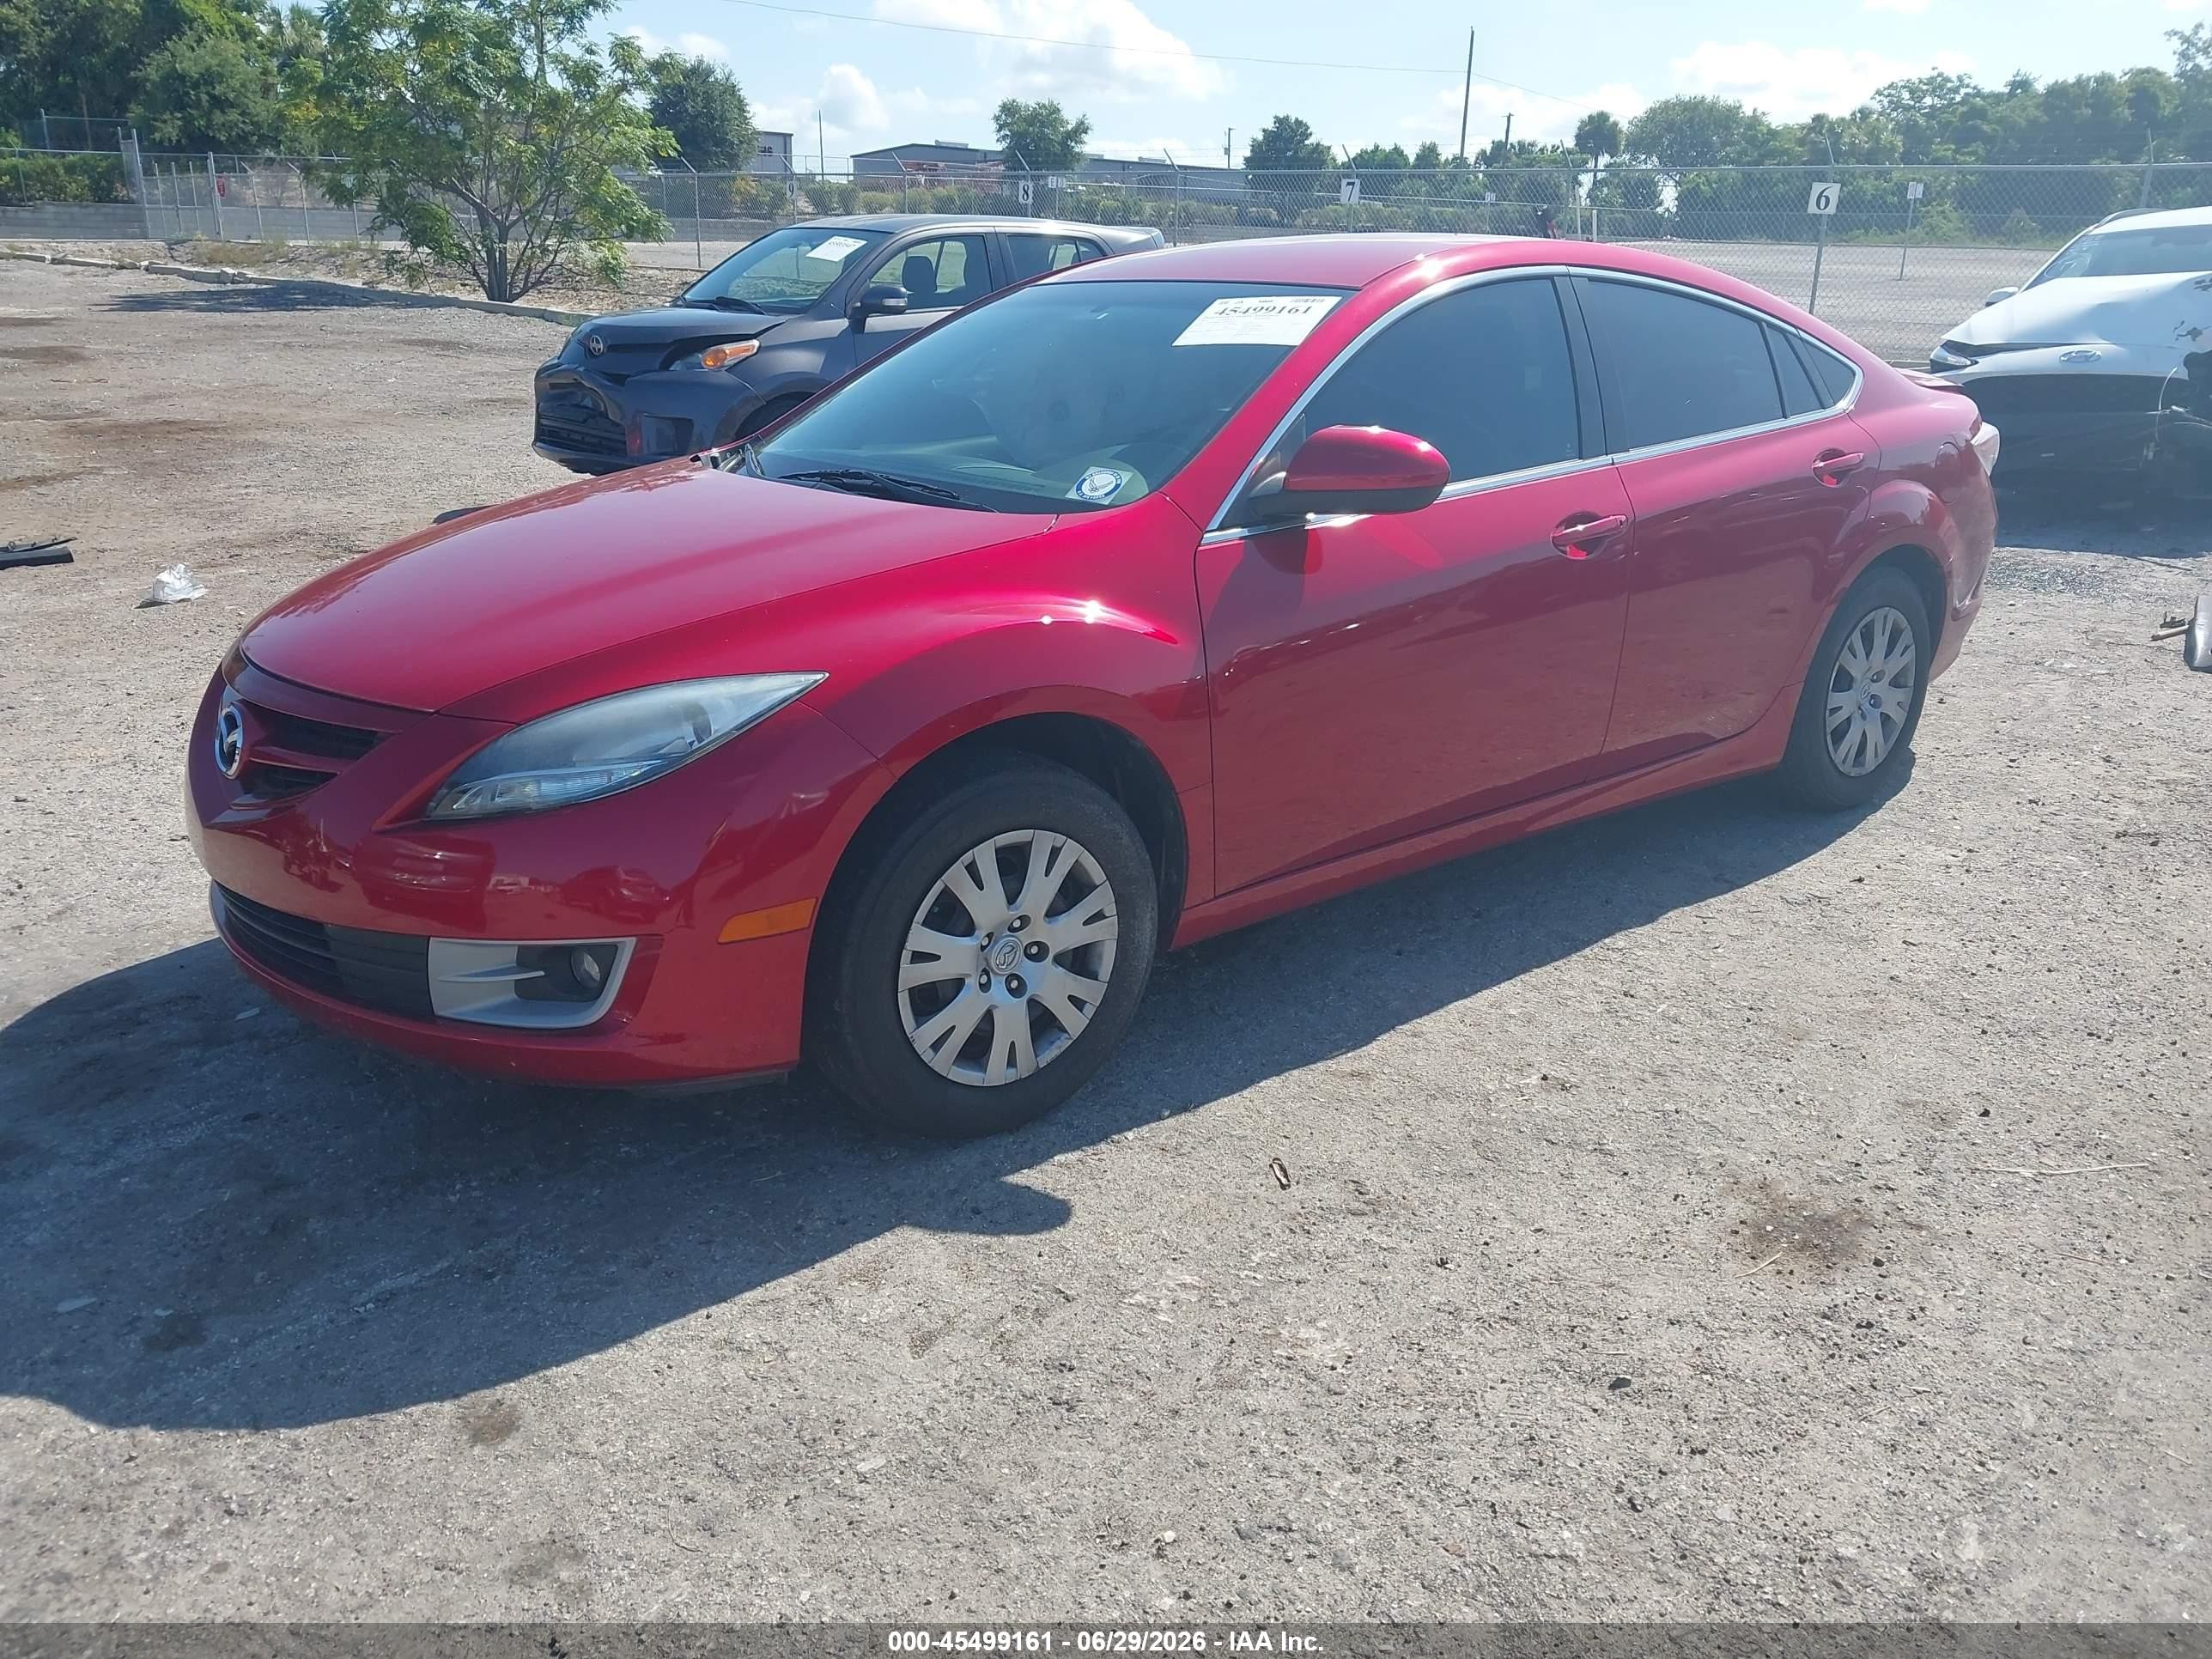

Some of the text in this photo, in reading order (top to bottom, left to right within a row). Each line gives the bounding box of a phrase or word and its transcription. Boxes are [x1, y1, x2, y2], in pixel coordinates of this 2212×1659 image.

[788, 182, 794, 198] 9
[1022, 184, 1030, 202] 8
[1346, 181, 1356, 202] 7
[1815, 185, 1834, 211] 6
[1214, 305, 1312, 315] 45499161
